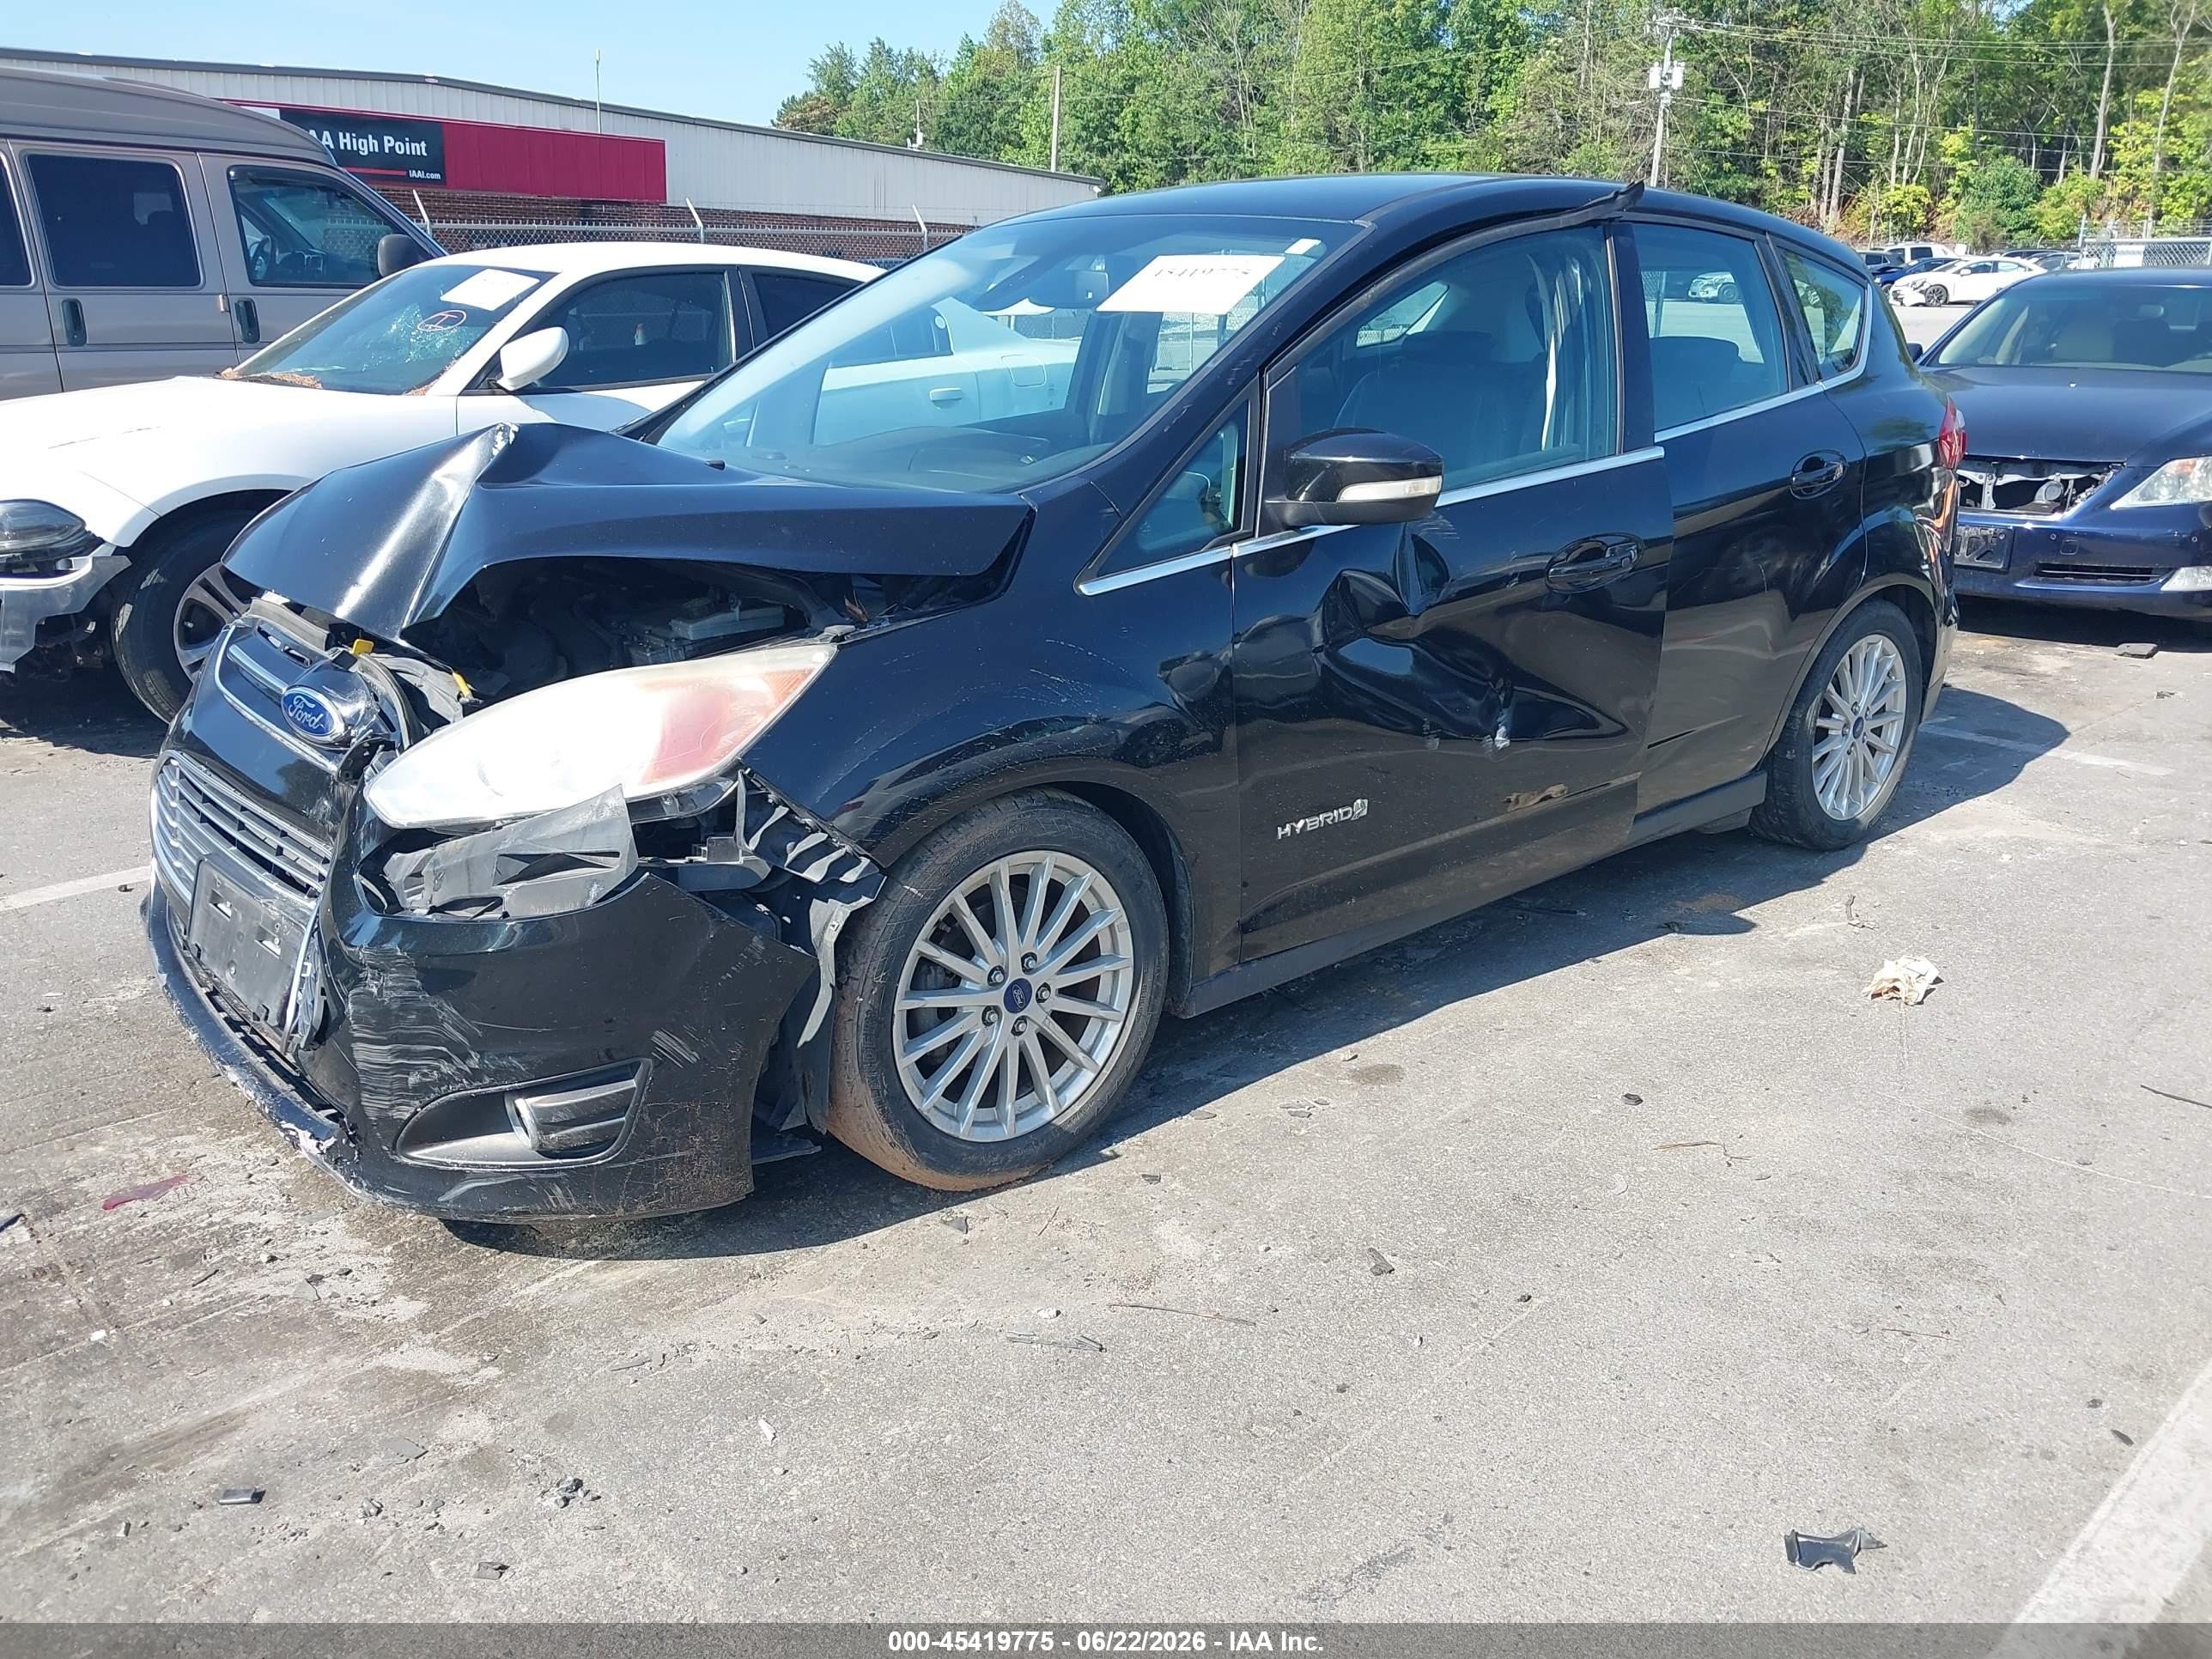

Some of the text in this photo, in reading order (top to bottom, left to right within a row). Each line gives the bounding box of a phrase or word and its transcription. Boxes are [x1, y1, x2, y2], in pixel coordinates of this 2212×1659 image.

[338, 131, 379, 155] High
[383, 136, 428, 156] Point
[409, 169, 441, 179] IAAI.com
[289, 696, 325, 729] Ford
[1276, 805, 1353, 840] HYBRID
